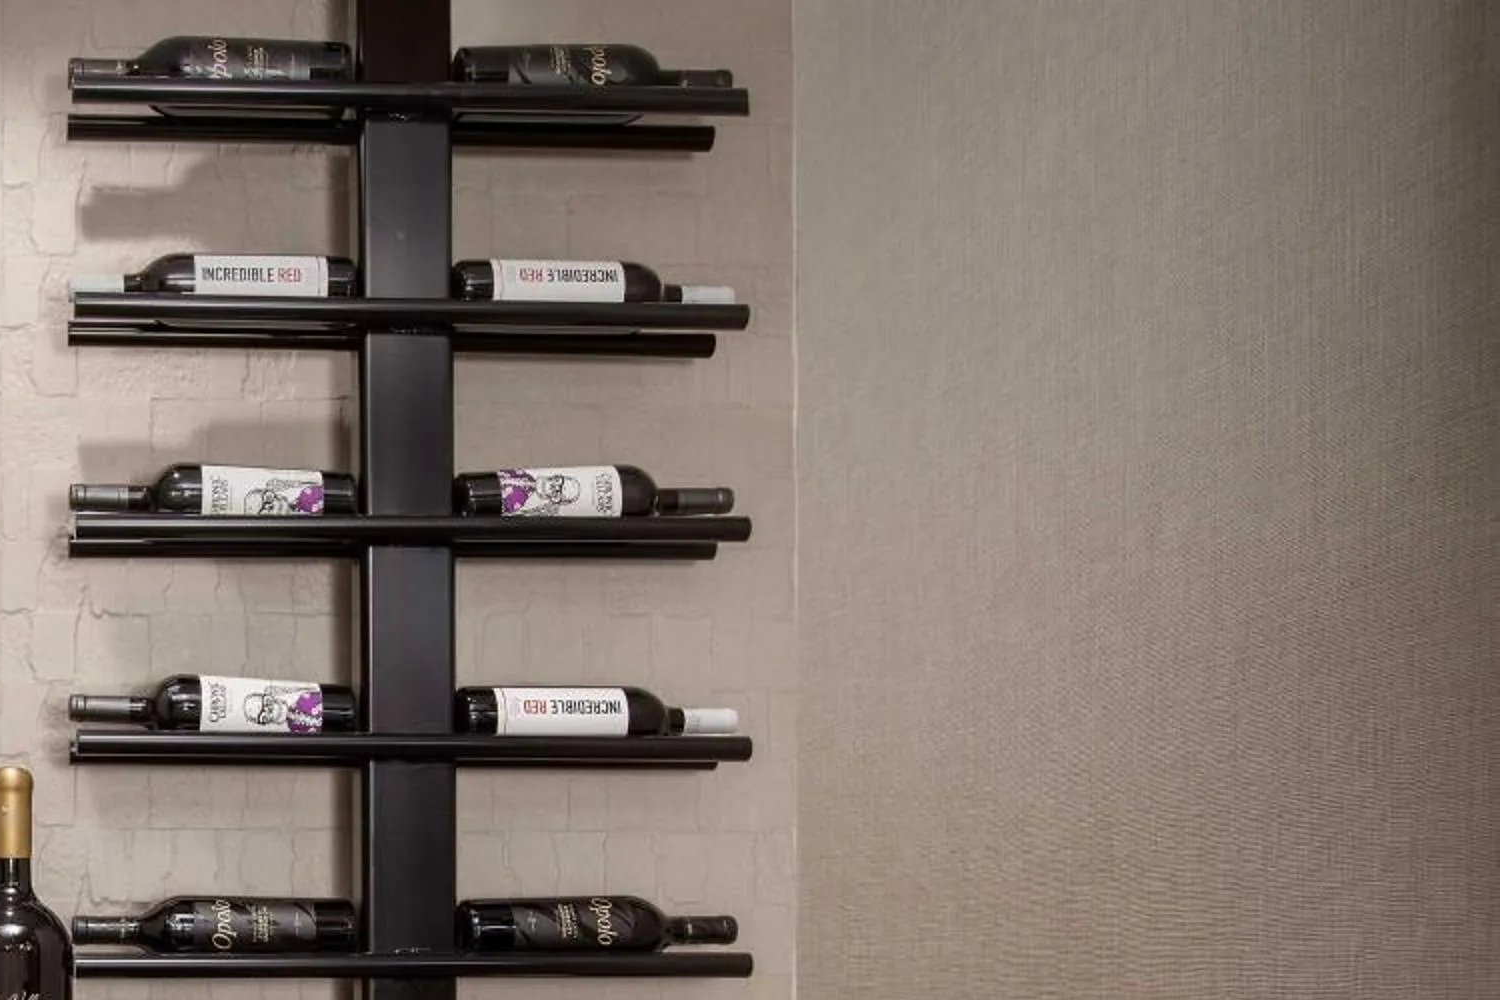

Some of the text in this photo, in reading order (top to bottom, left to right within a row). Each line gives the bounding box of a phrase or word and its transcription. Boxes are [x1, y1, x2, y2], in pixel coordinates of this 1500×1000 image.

[201, 267, 302, 283] INCREDIBLE RED
[519, 267, 619, 283] INCREDIBLE RED
[523, 699, 622, 715] INCREDIBLE RED
[211, 899, 237, 950] Opolo
[588, 897, 619, 945] Opolo
